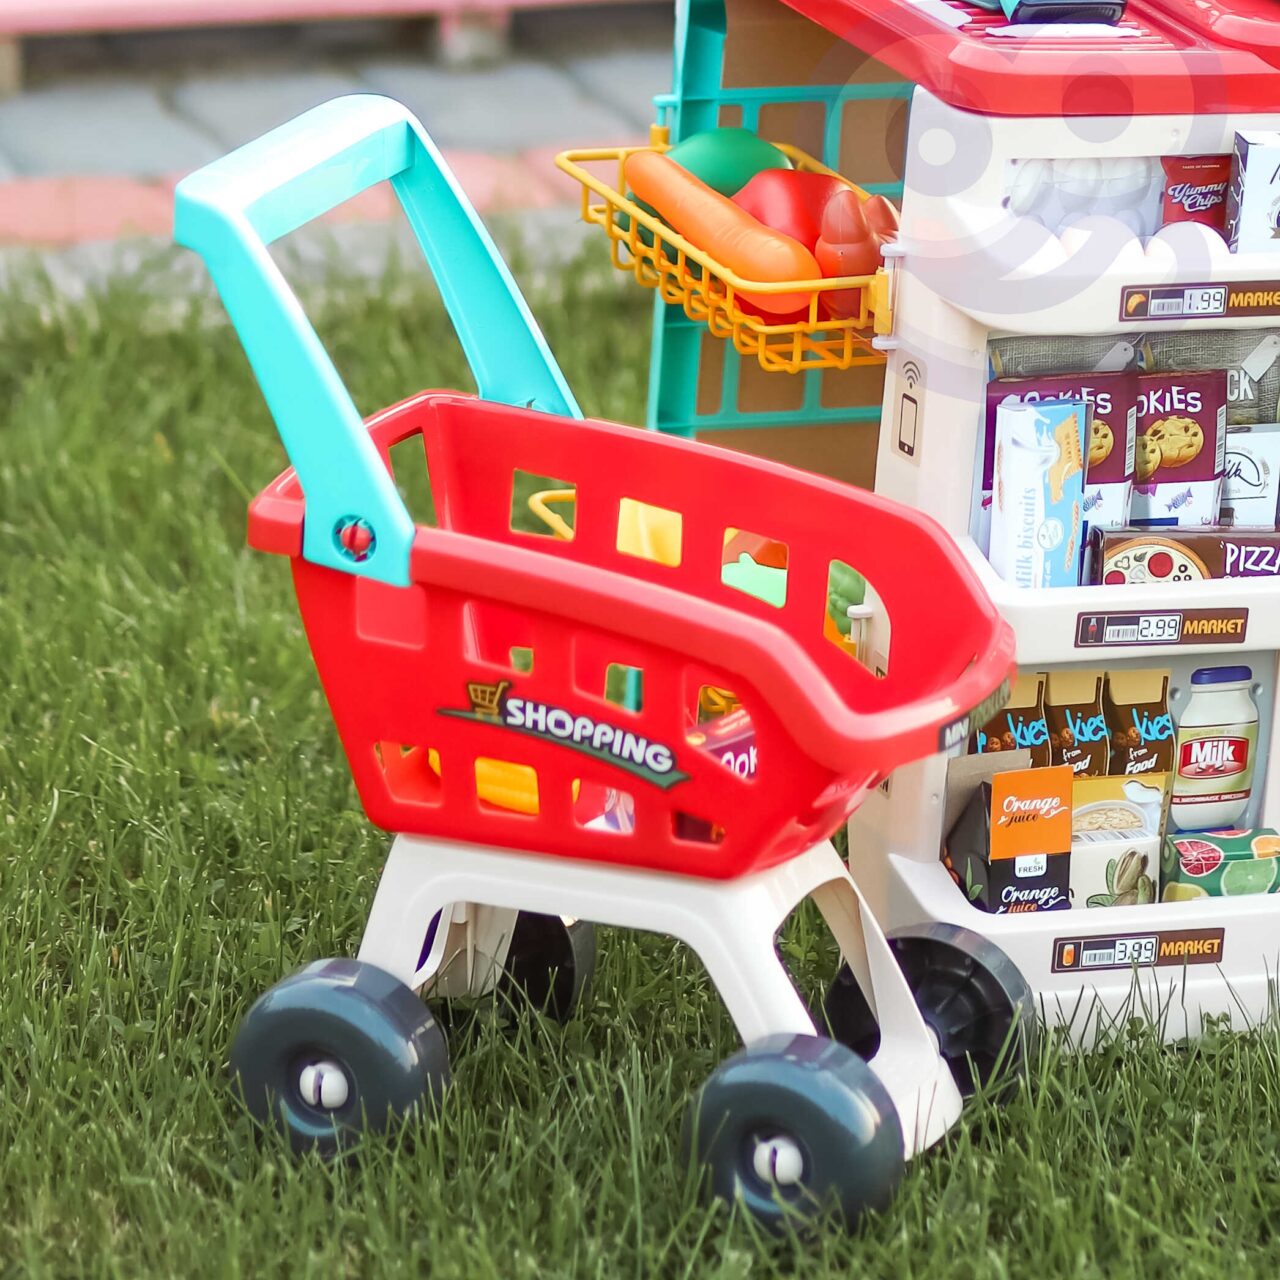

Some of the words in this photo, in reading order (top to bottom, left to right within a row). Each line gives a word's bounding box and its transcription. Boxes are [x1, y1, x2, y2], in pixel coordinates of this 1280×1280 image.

[1167, 182, 1228, 203] Yummy
[1182, 194, 1223, 212] Chips
[1187, 291, 1223, 311] 1.99
[1221, 459, 1262, 487] ilk
[1017, 487, 1036, 550] biscuits
[1139, 618, 1178, 638] 2.99
[1183, 618, 1245, 635] MARKET
[505, 698, 674, 772] SHOPPING
[1063, 754, 1092, 773] ood
[1125, 753, 1158, 775] Food
[1129, 747, 1148, 761] from
[1190, 740, 1236, 769] Milk
[1003, 795, 1068, 818] Orange
[1005, 812, 1039, 828] juice
[1018, 864, 1044, 874] FRESH
[1001, 885, 1067, 909] Orange
[1117, 941, 1154, 961] 3.99
[1160, 939, 1221, 957] MARKET
